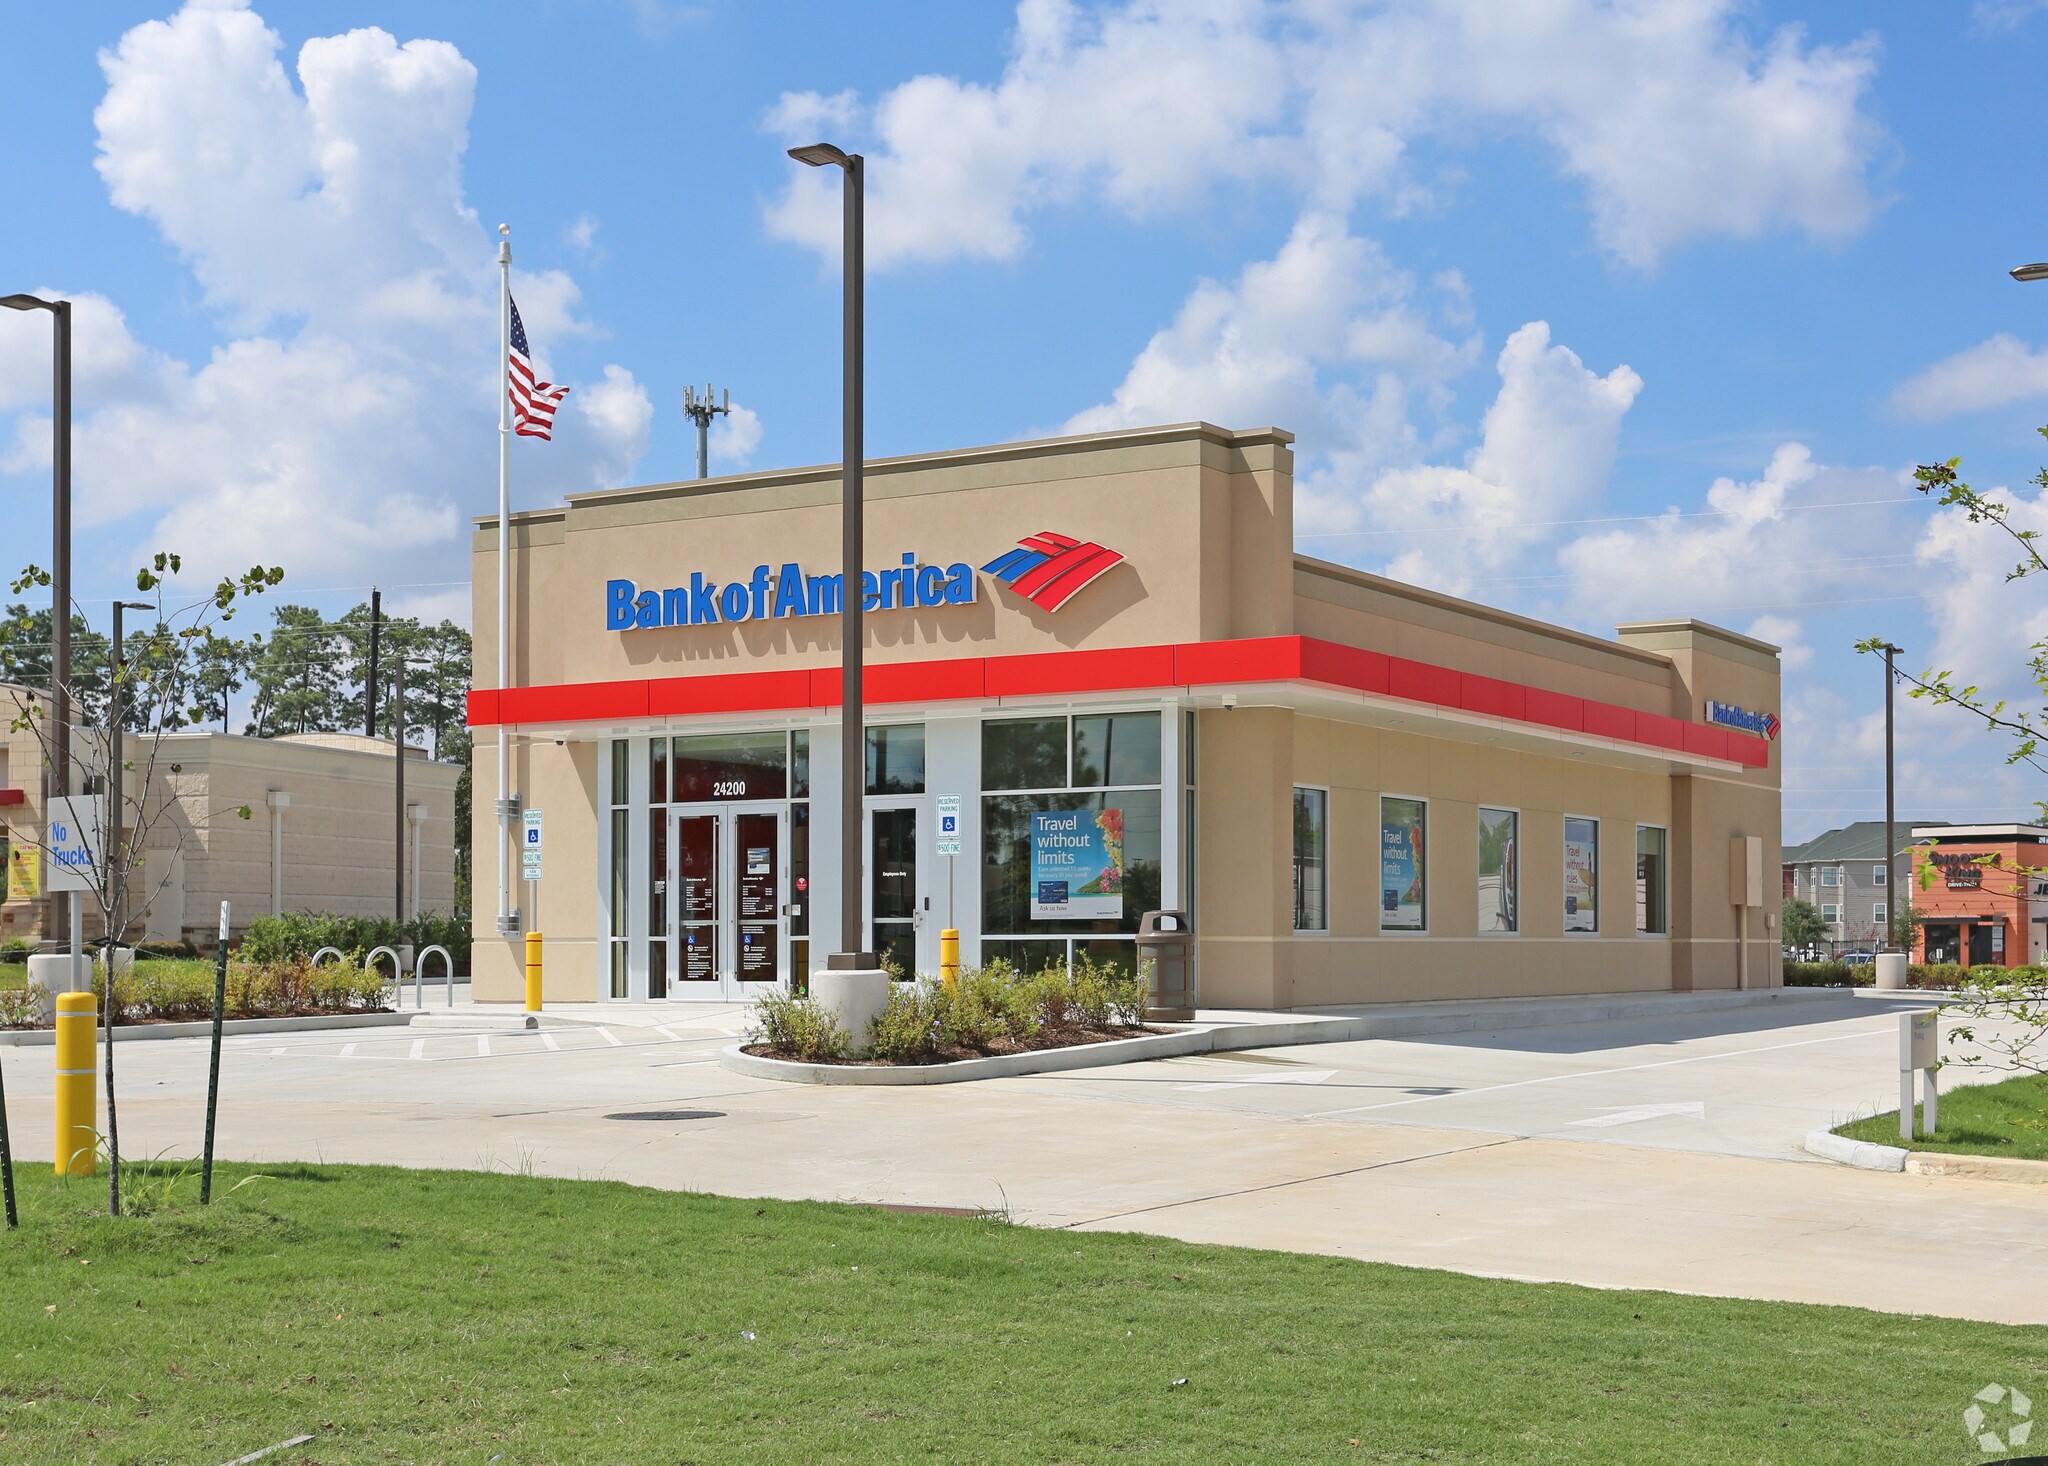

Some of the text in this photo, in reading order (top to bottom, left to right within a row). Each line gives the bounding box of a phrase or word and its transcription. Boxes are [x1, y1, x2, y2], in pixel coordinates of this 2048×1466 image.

[607, 551, 977, 631] Bank of America
[713, 781, 746, 797] 24200
[1036, 815, 1077, 831] Travel
[52, 822, 67, 842] No
[1383, 829, 1402, 844] Travel
[1036, 832, 1091, 848] without
[52, 845, 93, 866] Trucks
[951, 843, 960, 853] FINE
[1383, 846, 1408, 860] without
[1566, 844, 1580, 857] Travel
[1037, 849, 1075, 865] limits
[1383, 861, 1401, 875] limits
[1566, 859, 1585, 871] without
[1566, 871, 1578, 884] rules
